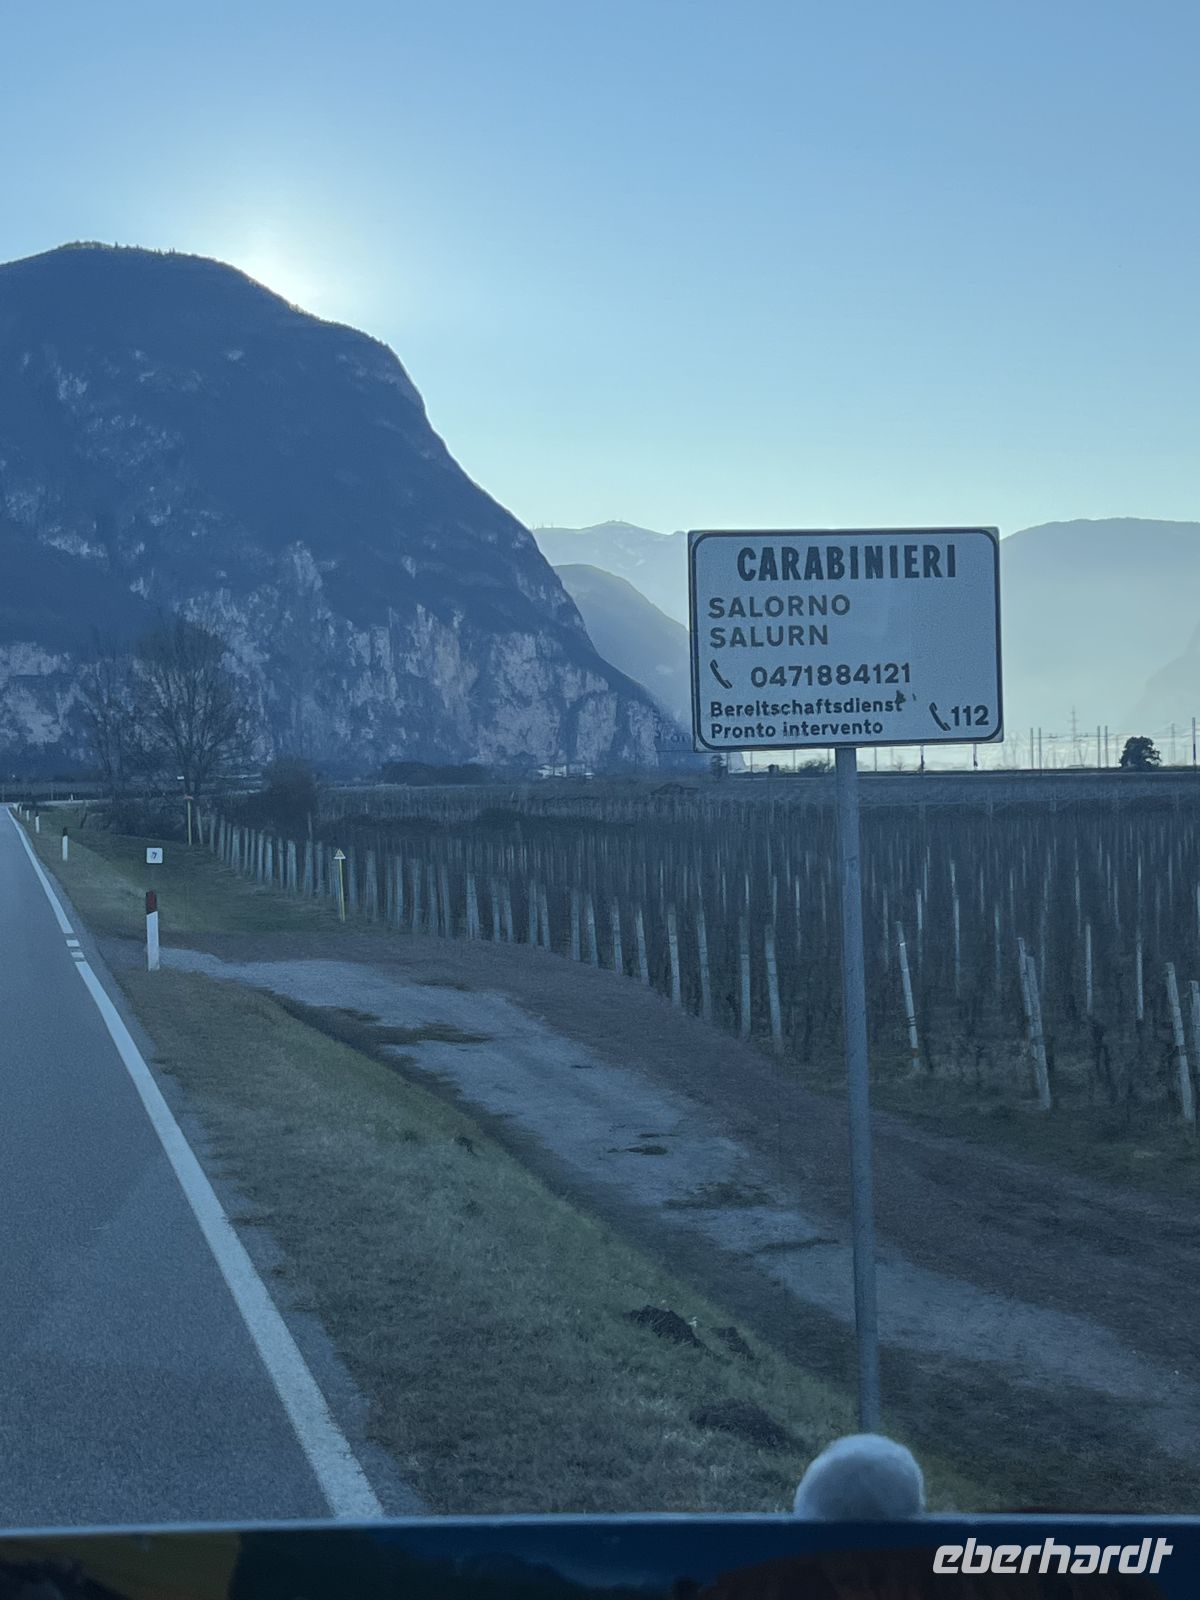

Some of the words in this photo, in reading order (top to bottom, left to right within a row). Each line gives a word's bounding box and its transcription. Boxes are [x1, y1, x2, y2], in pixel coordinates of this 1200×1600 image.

[737, 544, 957, 582] CARABINIERI
[708, 594, 851, 619] SALORNO
[709, 624, 829, 649] SALURN
[750, 662, 911, 688] 0471884121
[951, 704, 989, 727] 112
[711, 722, 777, 739] Pronto
[783, 719, 884, 738] intervento
